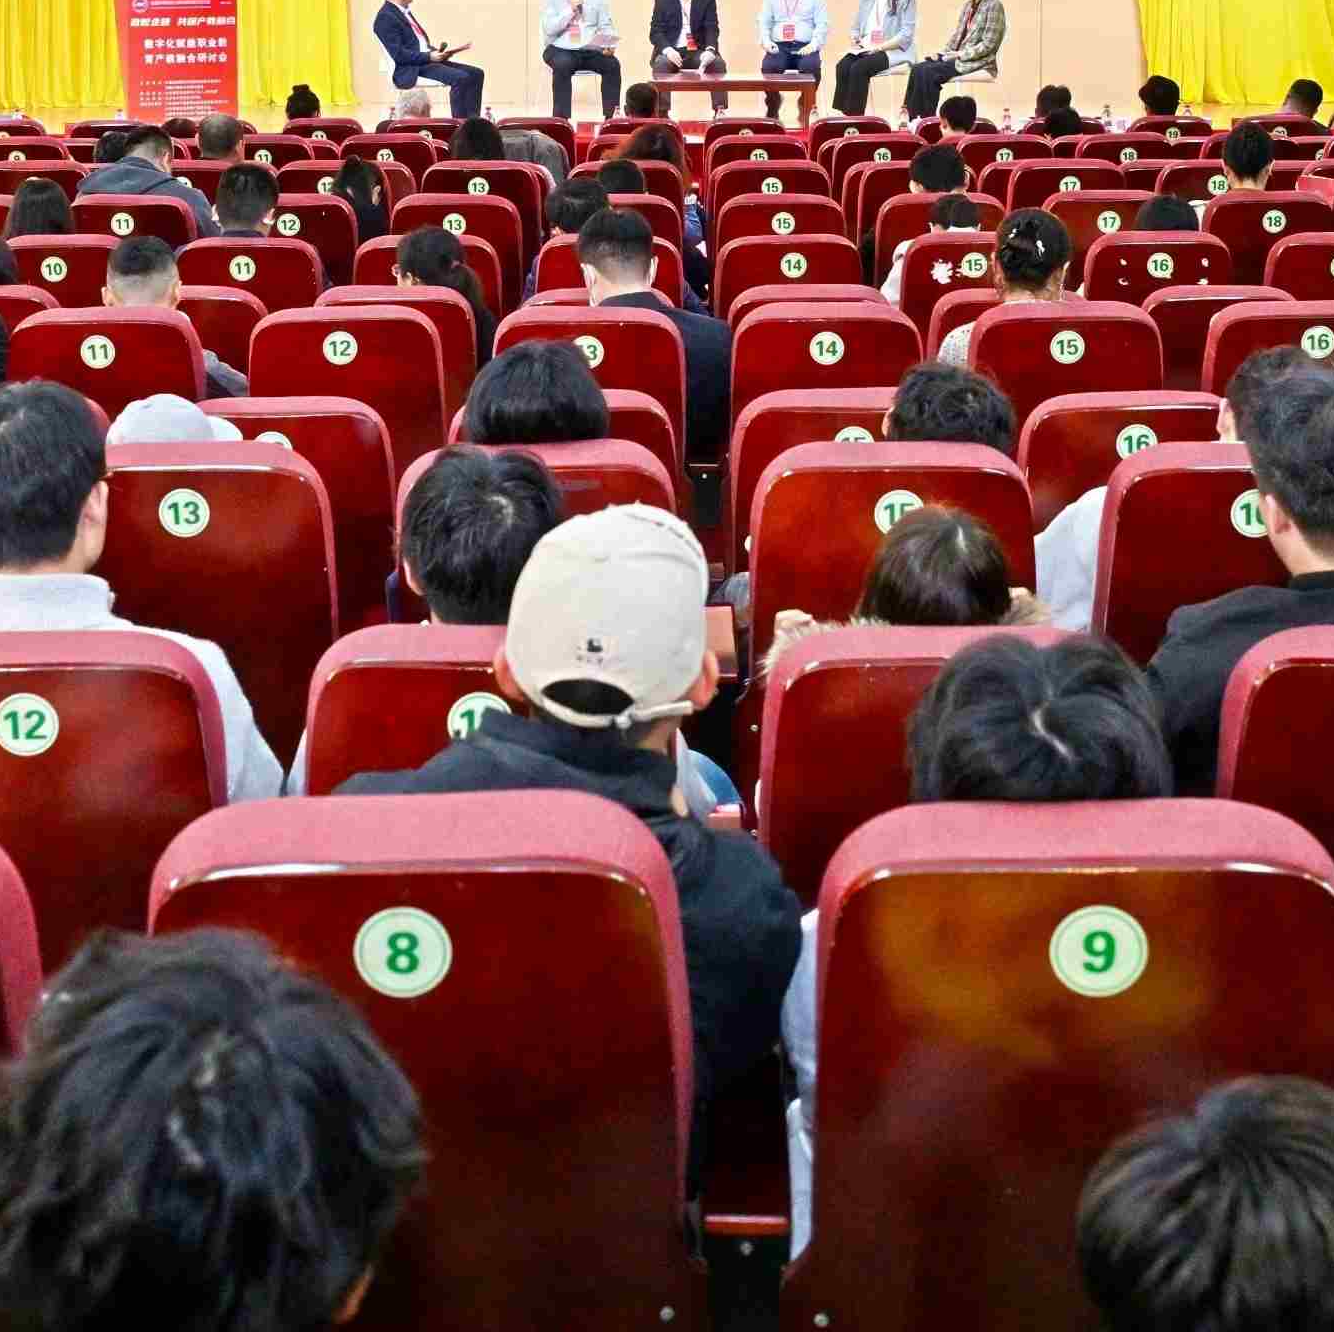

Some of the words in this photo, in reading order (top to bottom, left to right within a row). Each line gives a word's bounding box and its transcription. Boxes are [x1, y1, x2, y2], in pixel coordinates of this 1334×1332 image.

[753, 152, 765, 160] 15
[877, 152, 889, 161] 16
[999, 152, 1010, 161] 17
[1123, 151, 1135, 161] 18
[471, 182, 485, 193] 13
[765, 182, 779, 192] 15
[1063, 181, 1076, 191] 17
[1211, 180, 1225, 191] 18
[115, 218, 129, 230] 11
[281, 219, 297, 231] 12
[447, 219, 462, 231] 13
[776, 218, 791, 230] 15
[1102, 216, 1117, 228] 17
[1267, 215, 1282, 228] 18
[45, 262, 63, 276] 10
[235, 262, 251, 275] 11
[785, 259, 802, 272] 14
[965, 258, 983, 272] 15
[1151, 259, 1169, 272] 16
[329, 340, 351, 356] 12
[815, 340, 838, 356] 14
[1056, 339, 1079, 356] 15
[1307, 333, 1330, 350] 16
[87, 344, 108, 360] 11
[1122, 434, 1149, 454] 16
[167, 501, 200, 525] 13
[4, 710, 47, 740] 12
[386, 932, 420, 975] 8
[1083, 930, 1116, 974] 9
